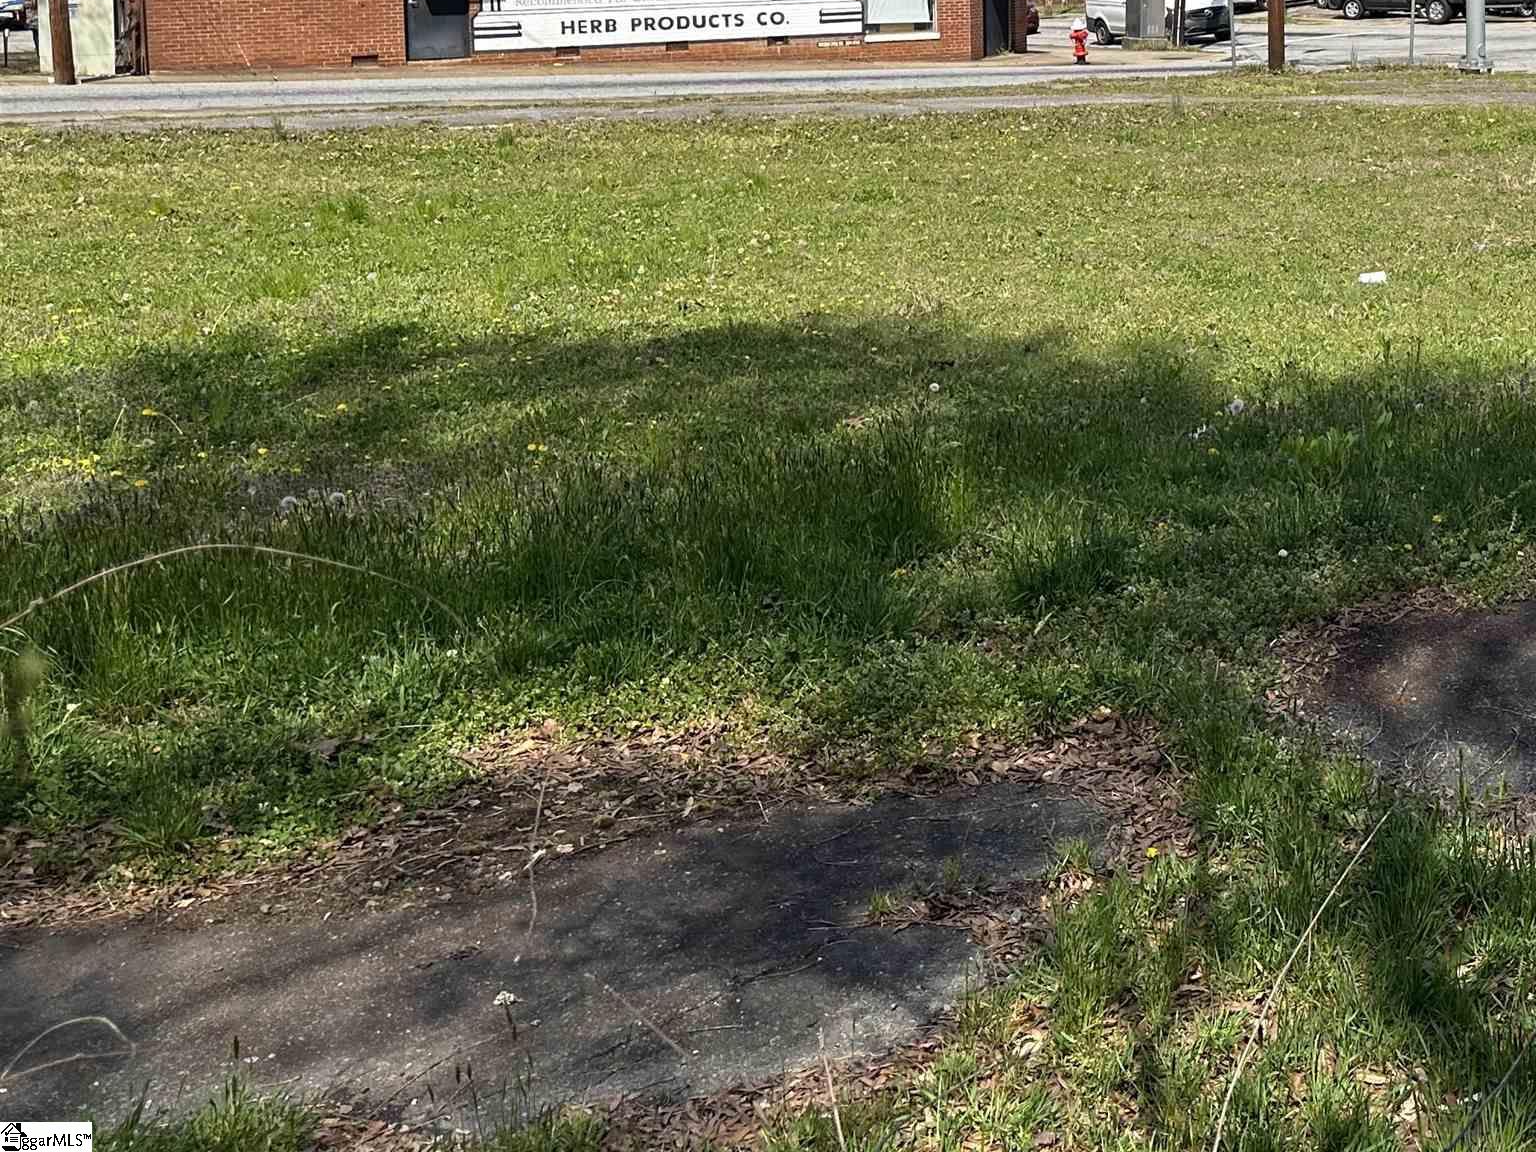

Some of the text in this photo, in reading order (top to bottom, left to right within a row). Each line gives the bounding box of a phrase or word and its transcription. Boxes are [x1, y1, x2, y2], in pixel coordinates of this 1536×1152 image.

[561, 11, 791, 35] HERB PRODUCTS CO.
